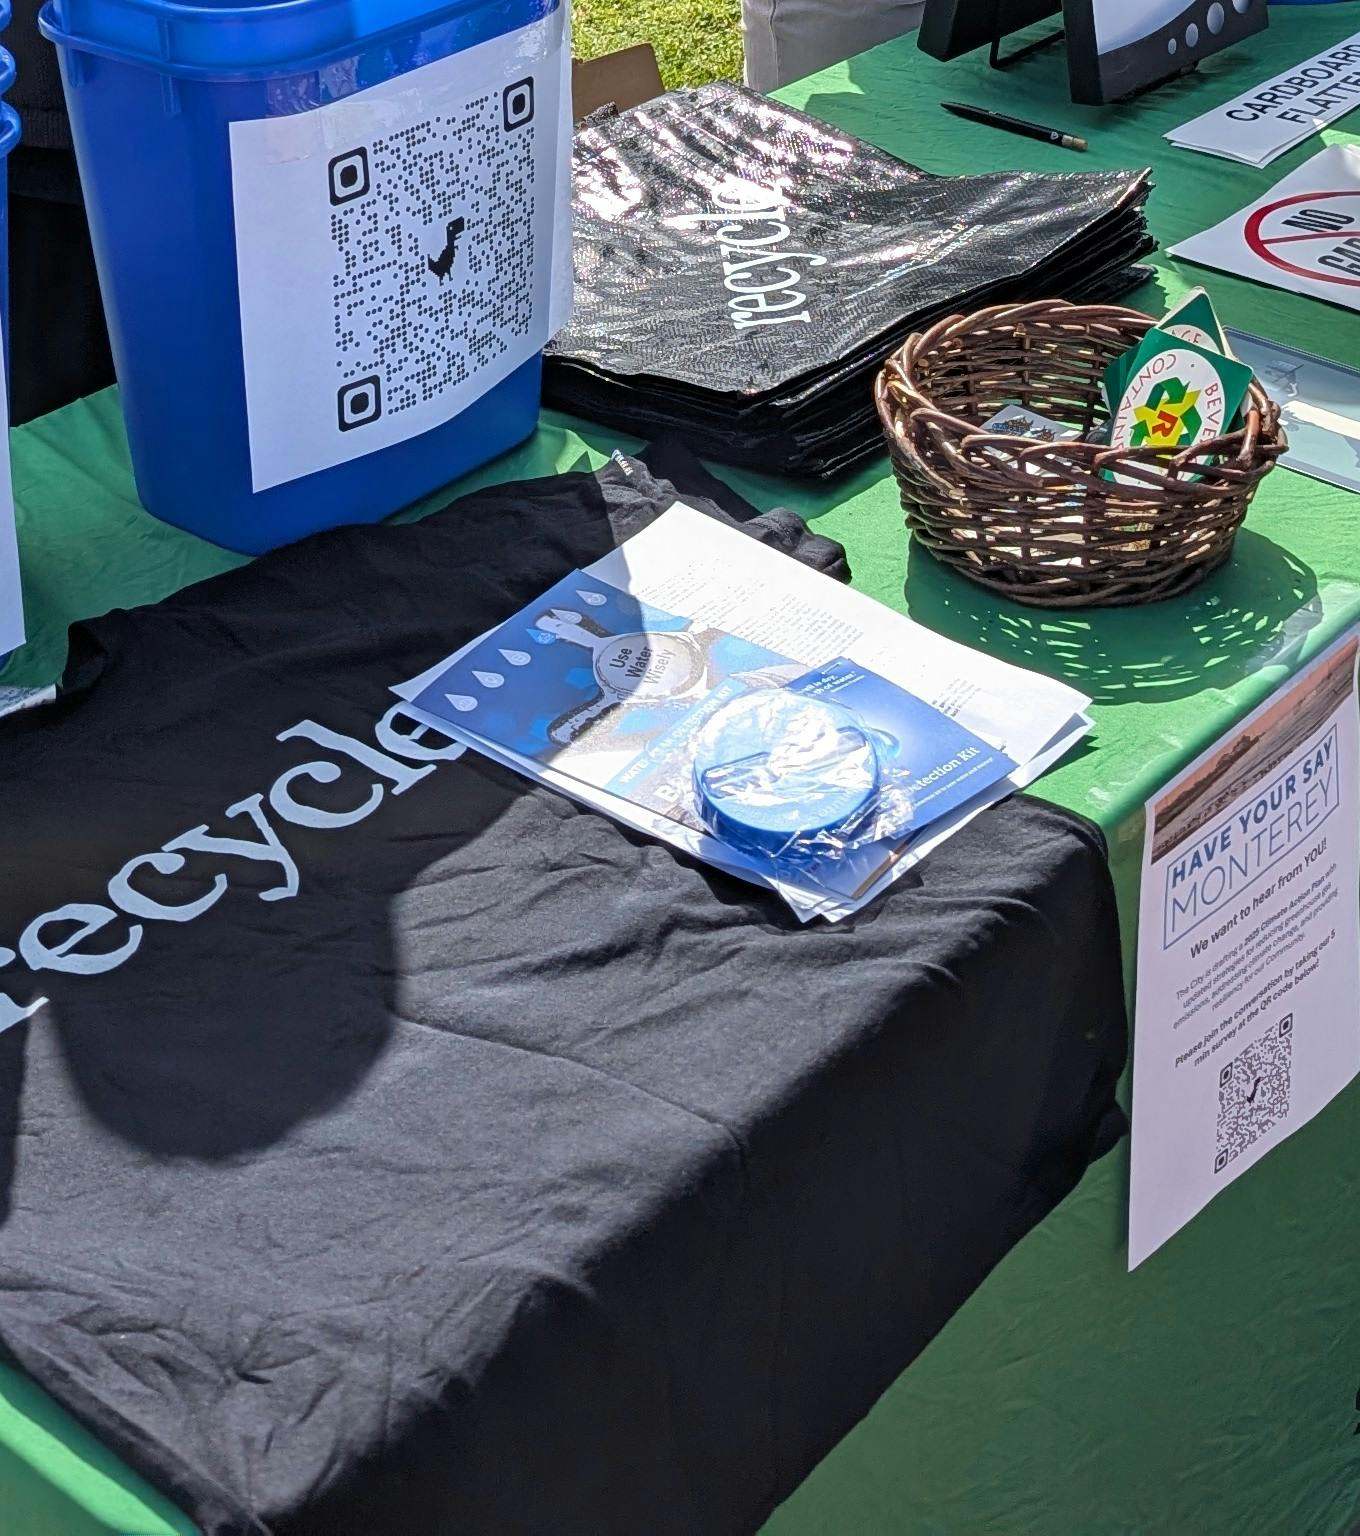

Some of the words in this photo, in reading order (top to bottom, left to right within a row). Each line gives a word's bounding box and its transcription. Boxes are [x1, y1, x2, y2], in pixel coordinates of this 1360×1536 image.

[686, 177, 828, 330] recycle
[1280, 208, 1355, 232] NO
[1201, 381, 1223, 442] BEVE
[609, 648, 632, 668] Use
[625, 646, 653, 678] Water
[644, 649, 676, 684] Wisely
[957, 744, 981, 763] Kit
[1170, 765, 1333, 933] MONTEREY
[1171, 824, 1232, 889] HAVE
[1238, 773, 1297, 835] YOUR
[1301, 734, 1333, 784] SAY
[1189, 938, 1209, 959] We
[1209, 913, 1238, 943] want
[1238, 905, 1251, 920] to
[1251, 882, 1276, 911] hear
[1276, 862, 1303, 890] from
[1303, 836, 1327, 867] YOU!
[1174, 1040, 1203, 1068] Please
[1201, 1027, 1219, 1048] join
[1218, 1015, 1233, 1031] the
[1233, 973, 1283, 1020] conversation
[1294, 945, 1318, 970] taking
[1317, 934, 1331, 951] our
[1193, 1048, 1211, 1067] min
[1210, 1025, 1238, 1053] survey
[1245, 1006, 1260, 1023] the
[1271, 974, 1294, 1001] code
[1293, 952, 1320, 986] below!
